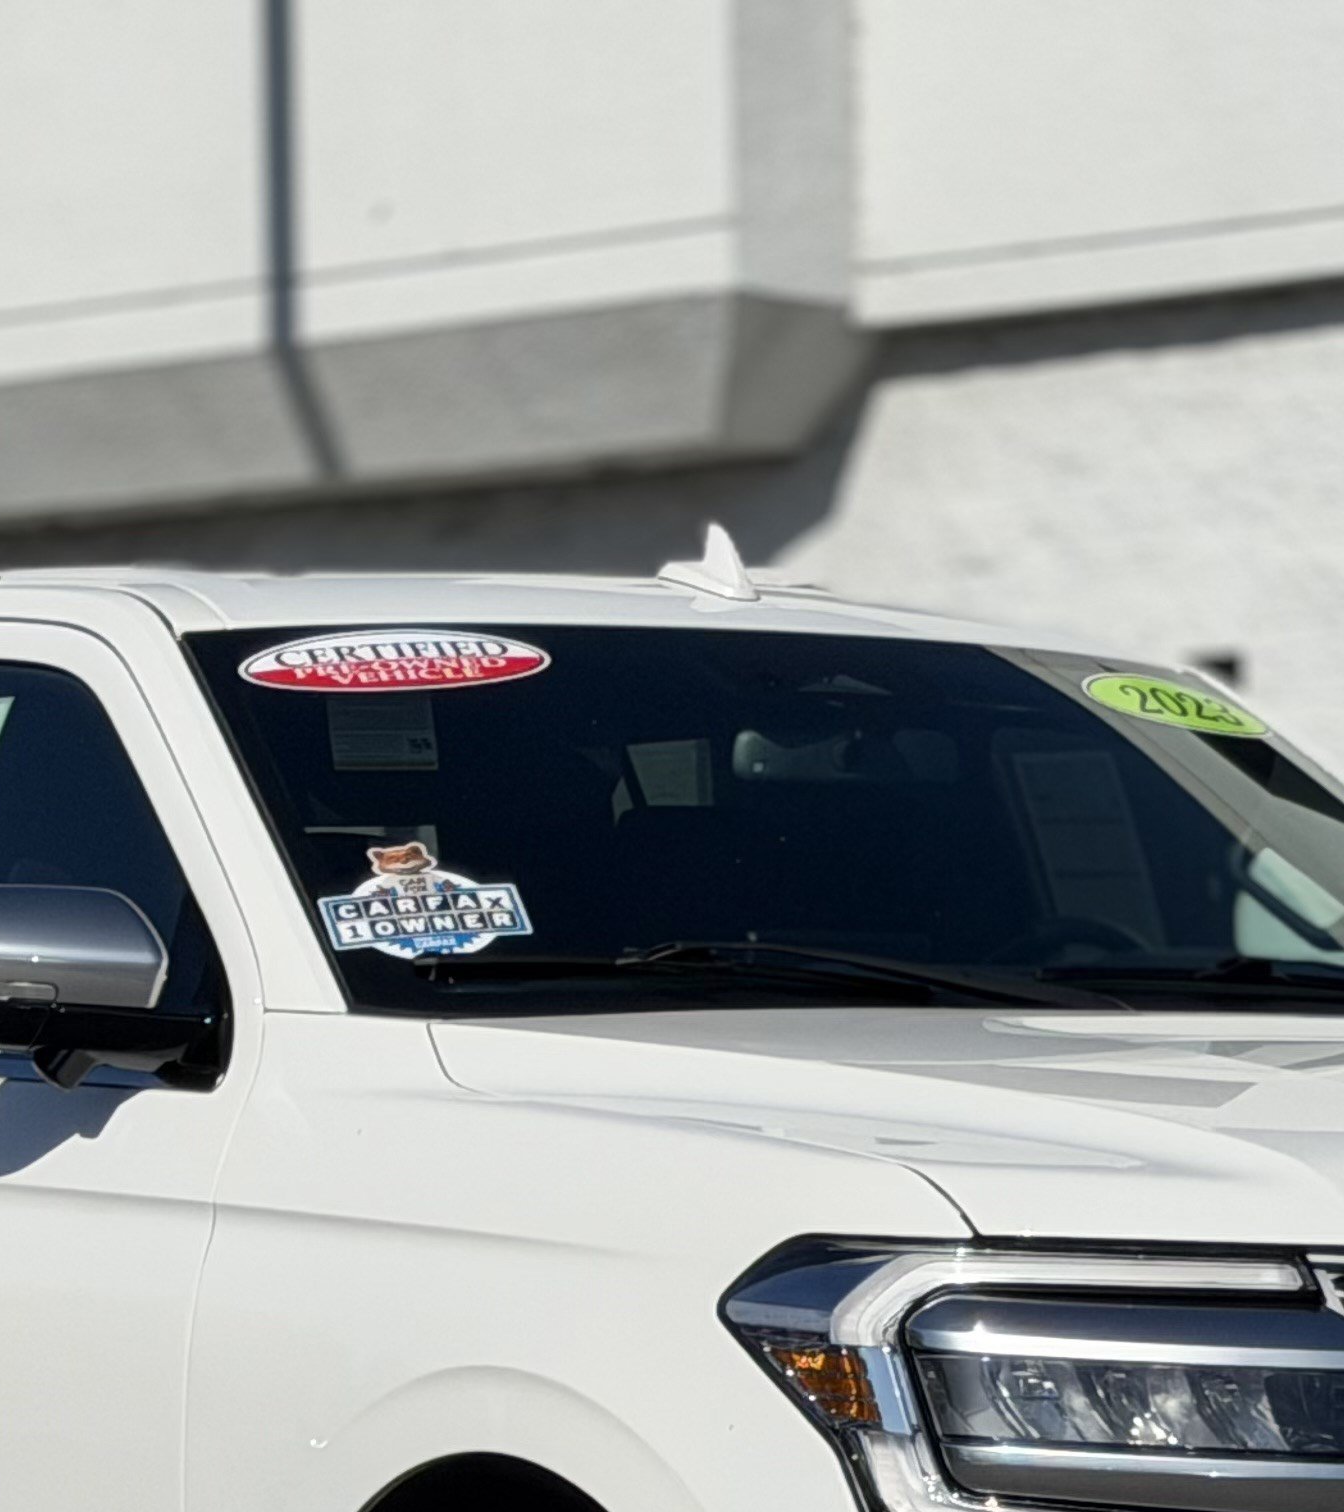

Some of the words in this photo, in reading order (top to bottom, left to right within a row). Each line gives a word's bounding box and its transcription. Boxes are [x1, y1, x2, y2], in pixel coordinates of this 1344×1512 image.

[274, 640, 508, 668] CERTIFIED
[293, 656, 506, 680] PRE-OWNED
[330, 665, 484, 685] VEHICLE
[337, 891, 507, 921] CARFAX
[347, 922, 364, 940] 1
[373, 911, 514, 937] OWNER
